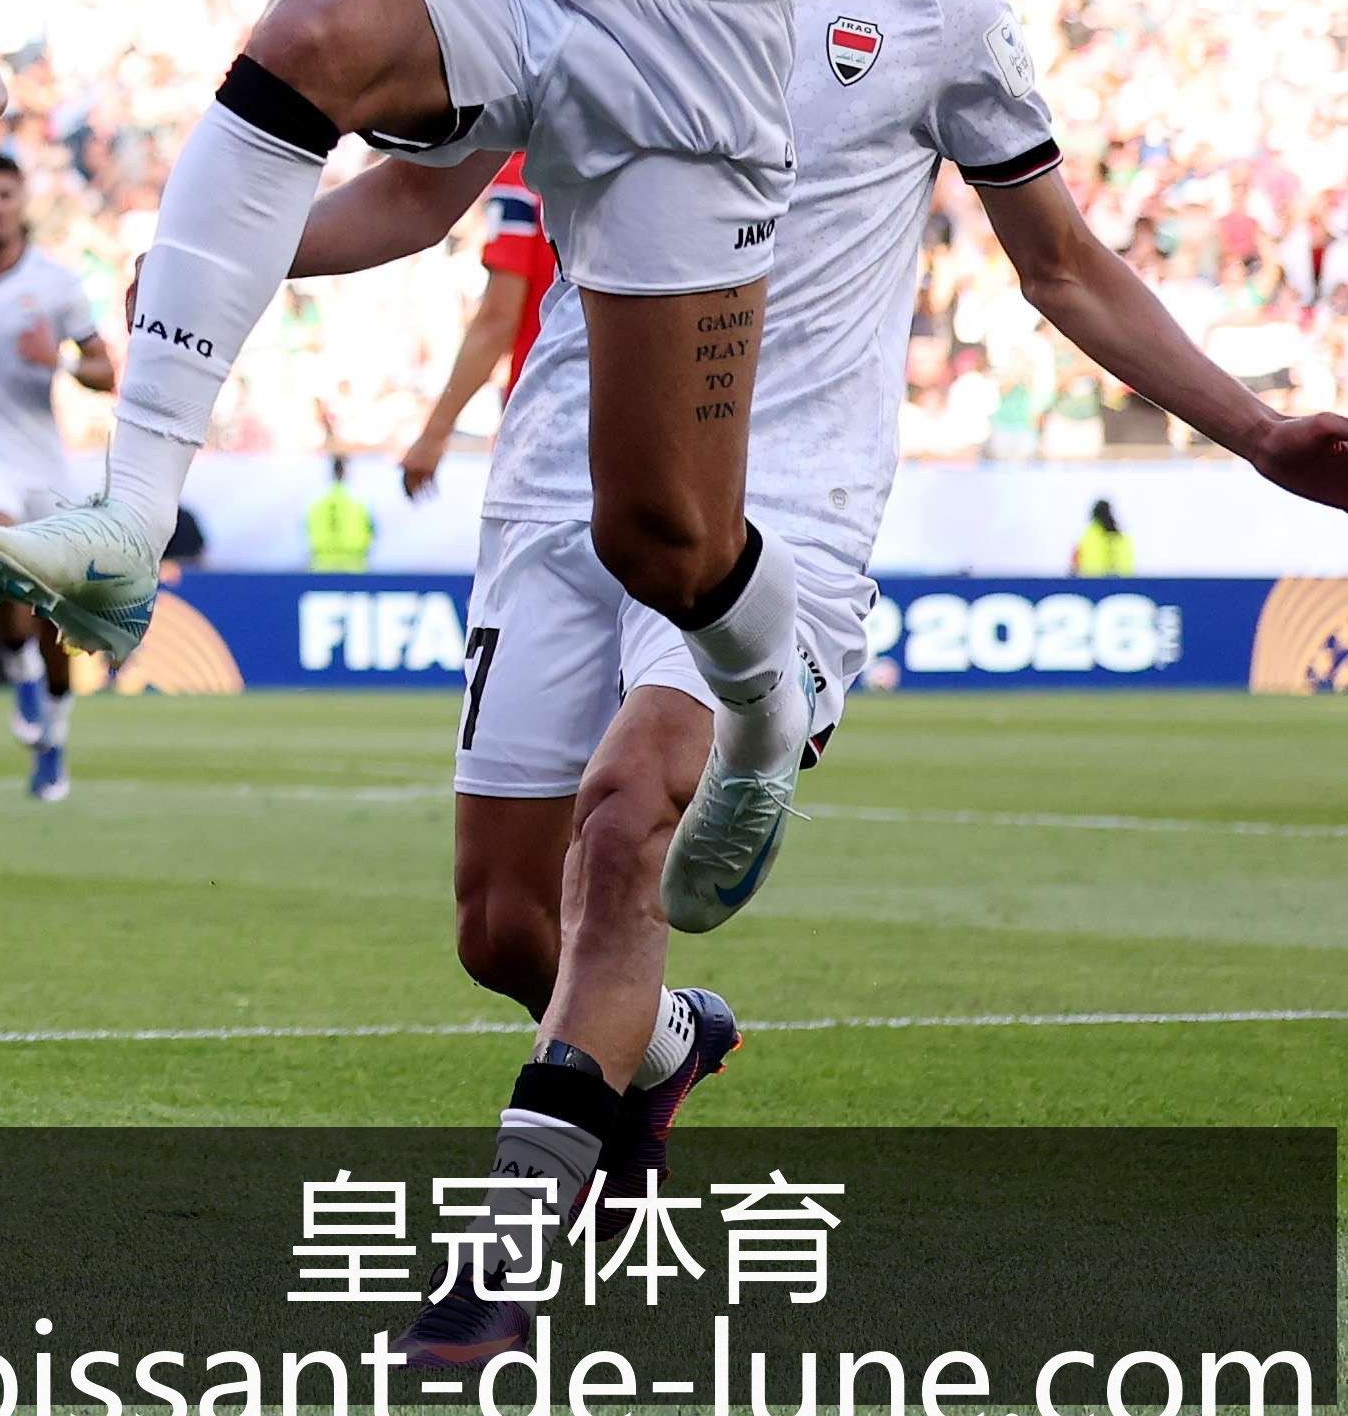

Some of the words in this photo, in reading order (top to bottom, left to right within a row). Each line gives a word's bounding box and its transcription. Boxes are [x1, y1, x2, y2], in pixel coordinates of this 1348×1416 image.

[841, 21, 873, 34] IRAQ
[734, 218, 776, 250] JAKO
[697, 309, 754, 333] GAME
[134, 314, 214, 359] JAKO
[695, 339, 749, 363] PLAY
[706, 372, 734, 391] TO
[695, 401, 736, 423] WIN
[299, 590, 465, 671] FIFA
[905, 592, 1157, 672] 2026
[462, 626, 500, 751] 7
